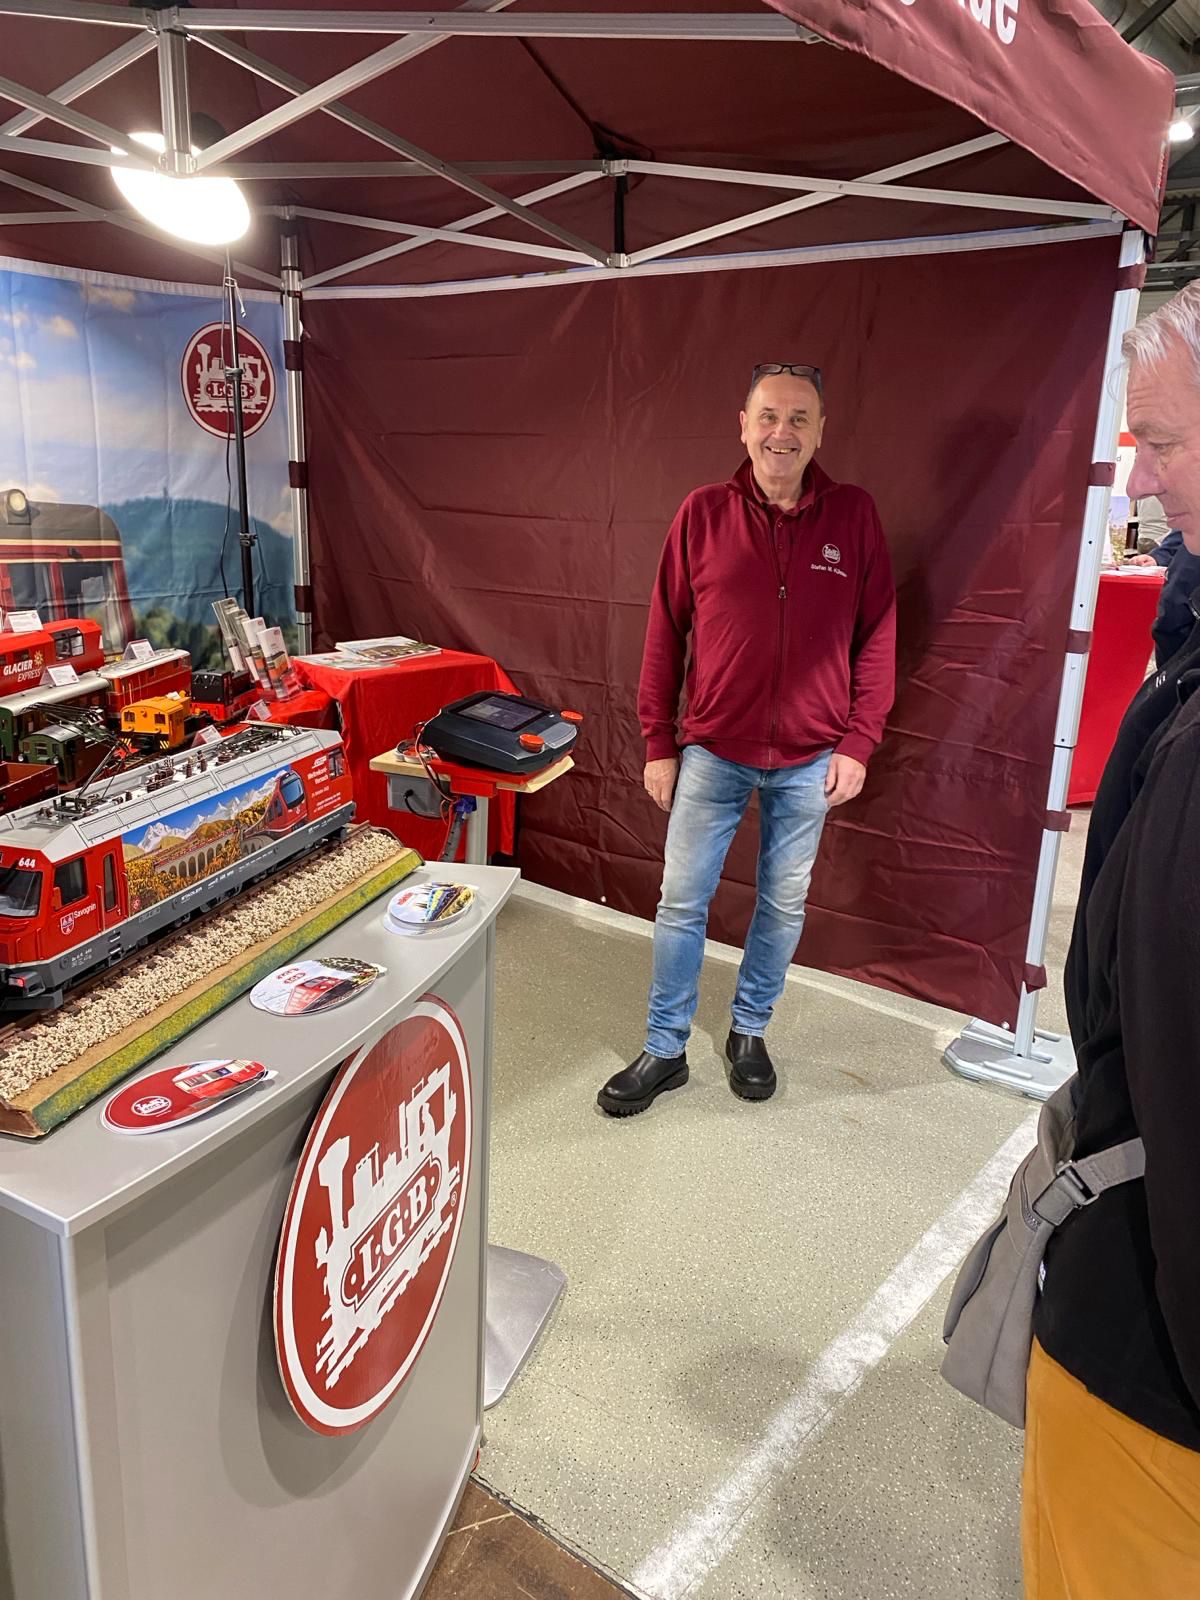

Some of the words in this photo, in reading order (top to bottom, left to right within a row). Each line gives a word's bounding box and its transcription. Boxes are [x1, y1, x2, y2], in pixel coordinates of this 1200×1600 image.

[3, 659, 33, 676] GLACIER
[17, 668, 41, 682] EXPRESS
[18, 857, 36, 868] 644
[73, 903, 97, 918] Savognin
